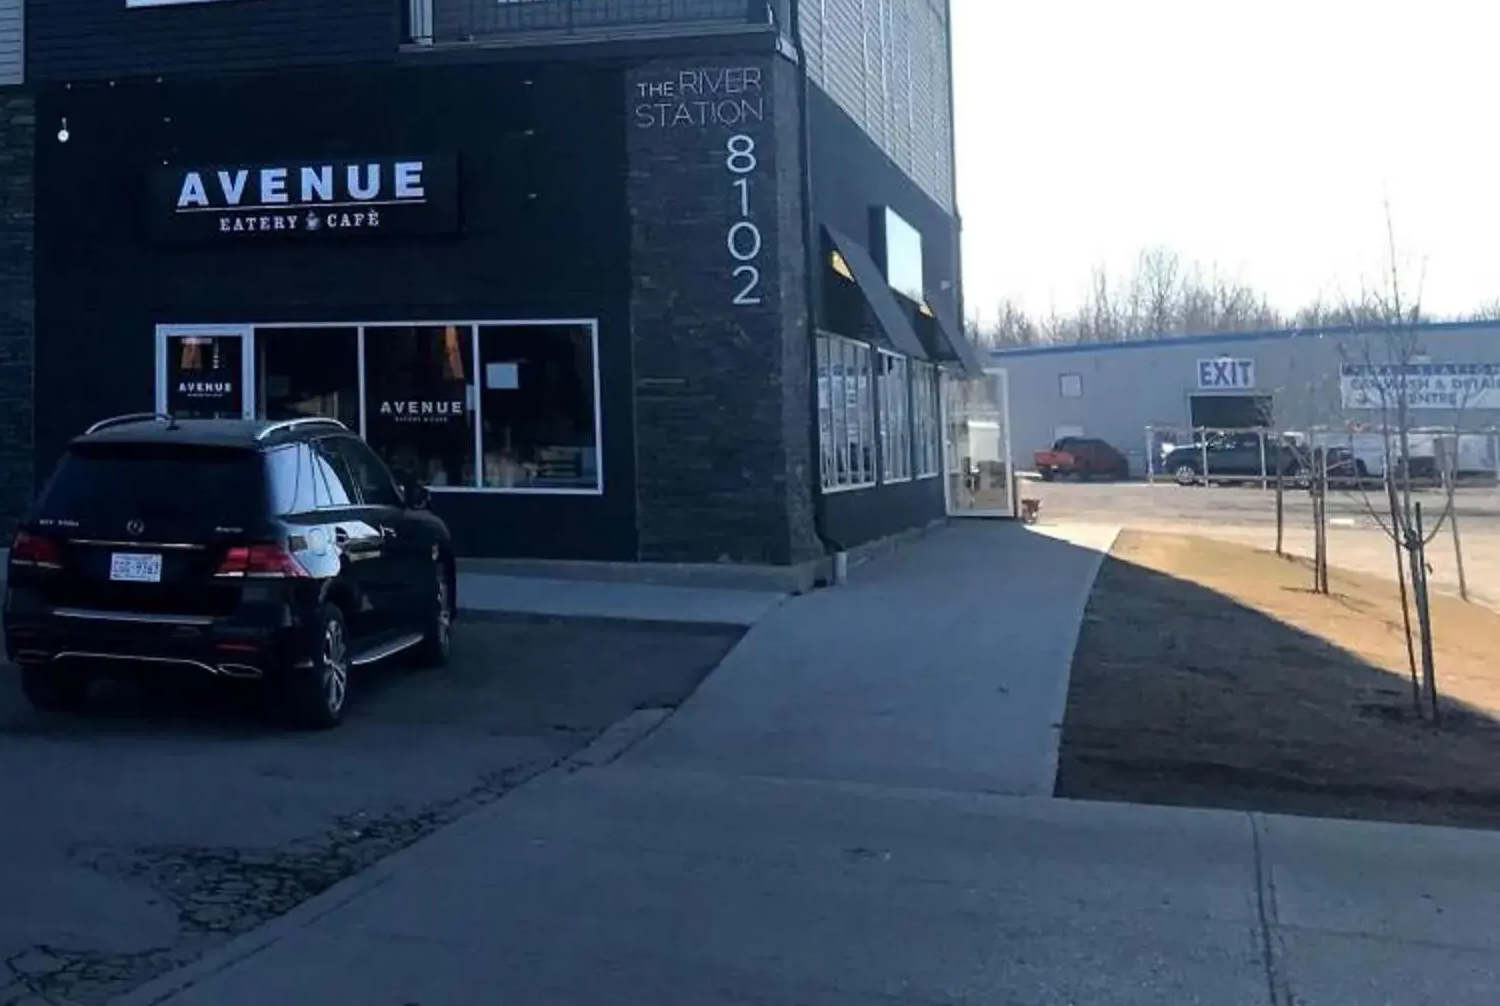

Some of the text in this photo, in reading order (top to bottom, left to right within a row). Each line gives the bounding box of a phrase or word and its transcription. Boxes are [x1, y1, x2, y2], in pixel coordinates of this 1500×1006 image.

[636, 67, 762, 98] THE RIVER
[636, 98, 763, 128] STATION
[177, 161, 425, 207] AVENUE
[219, 216, 298, 231] EATERY
[726, 134, 762, 305] 8102
[179, 382, 233, 393] AVENUE
[1200, 361, 1252, 387] EXIT
[380, 400, 463, 415] AVENUE
